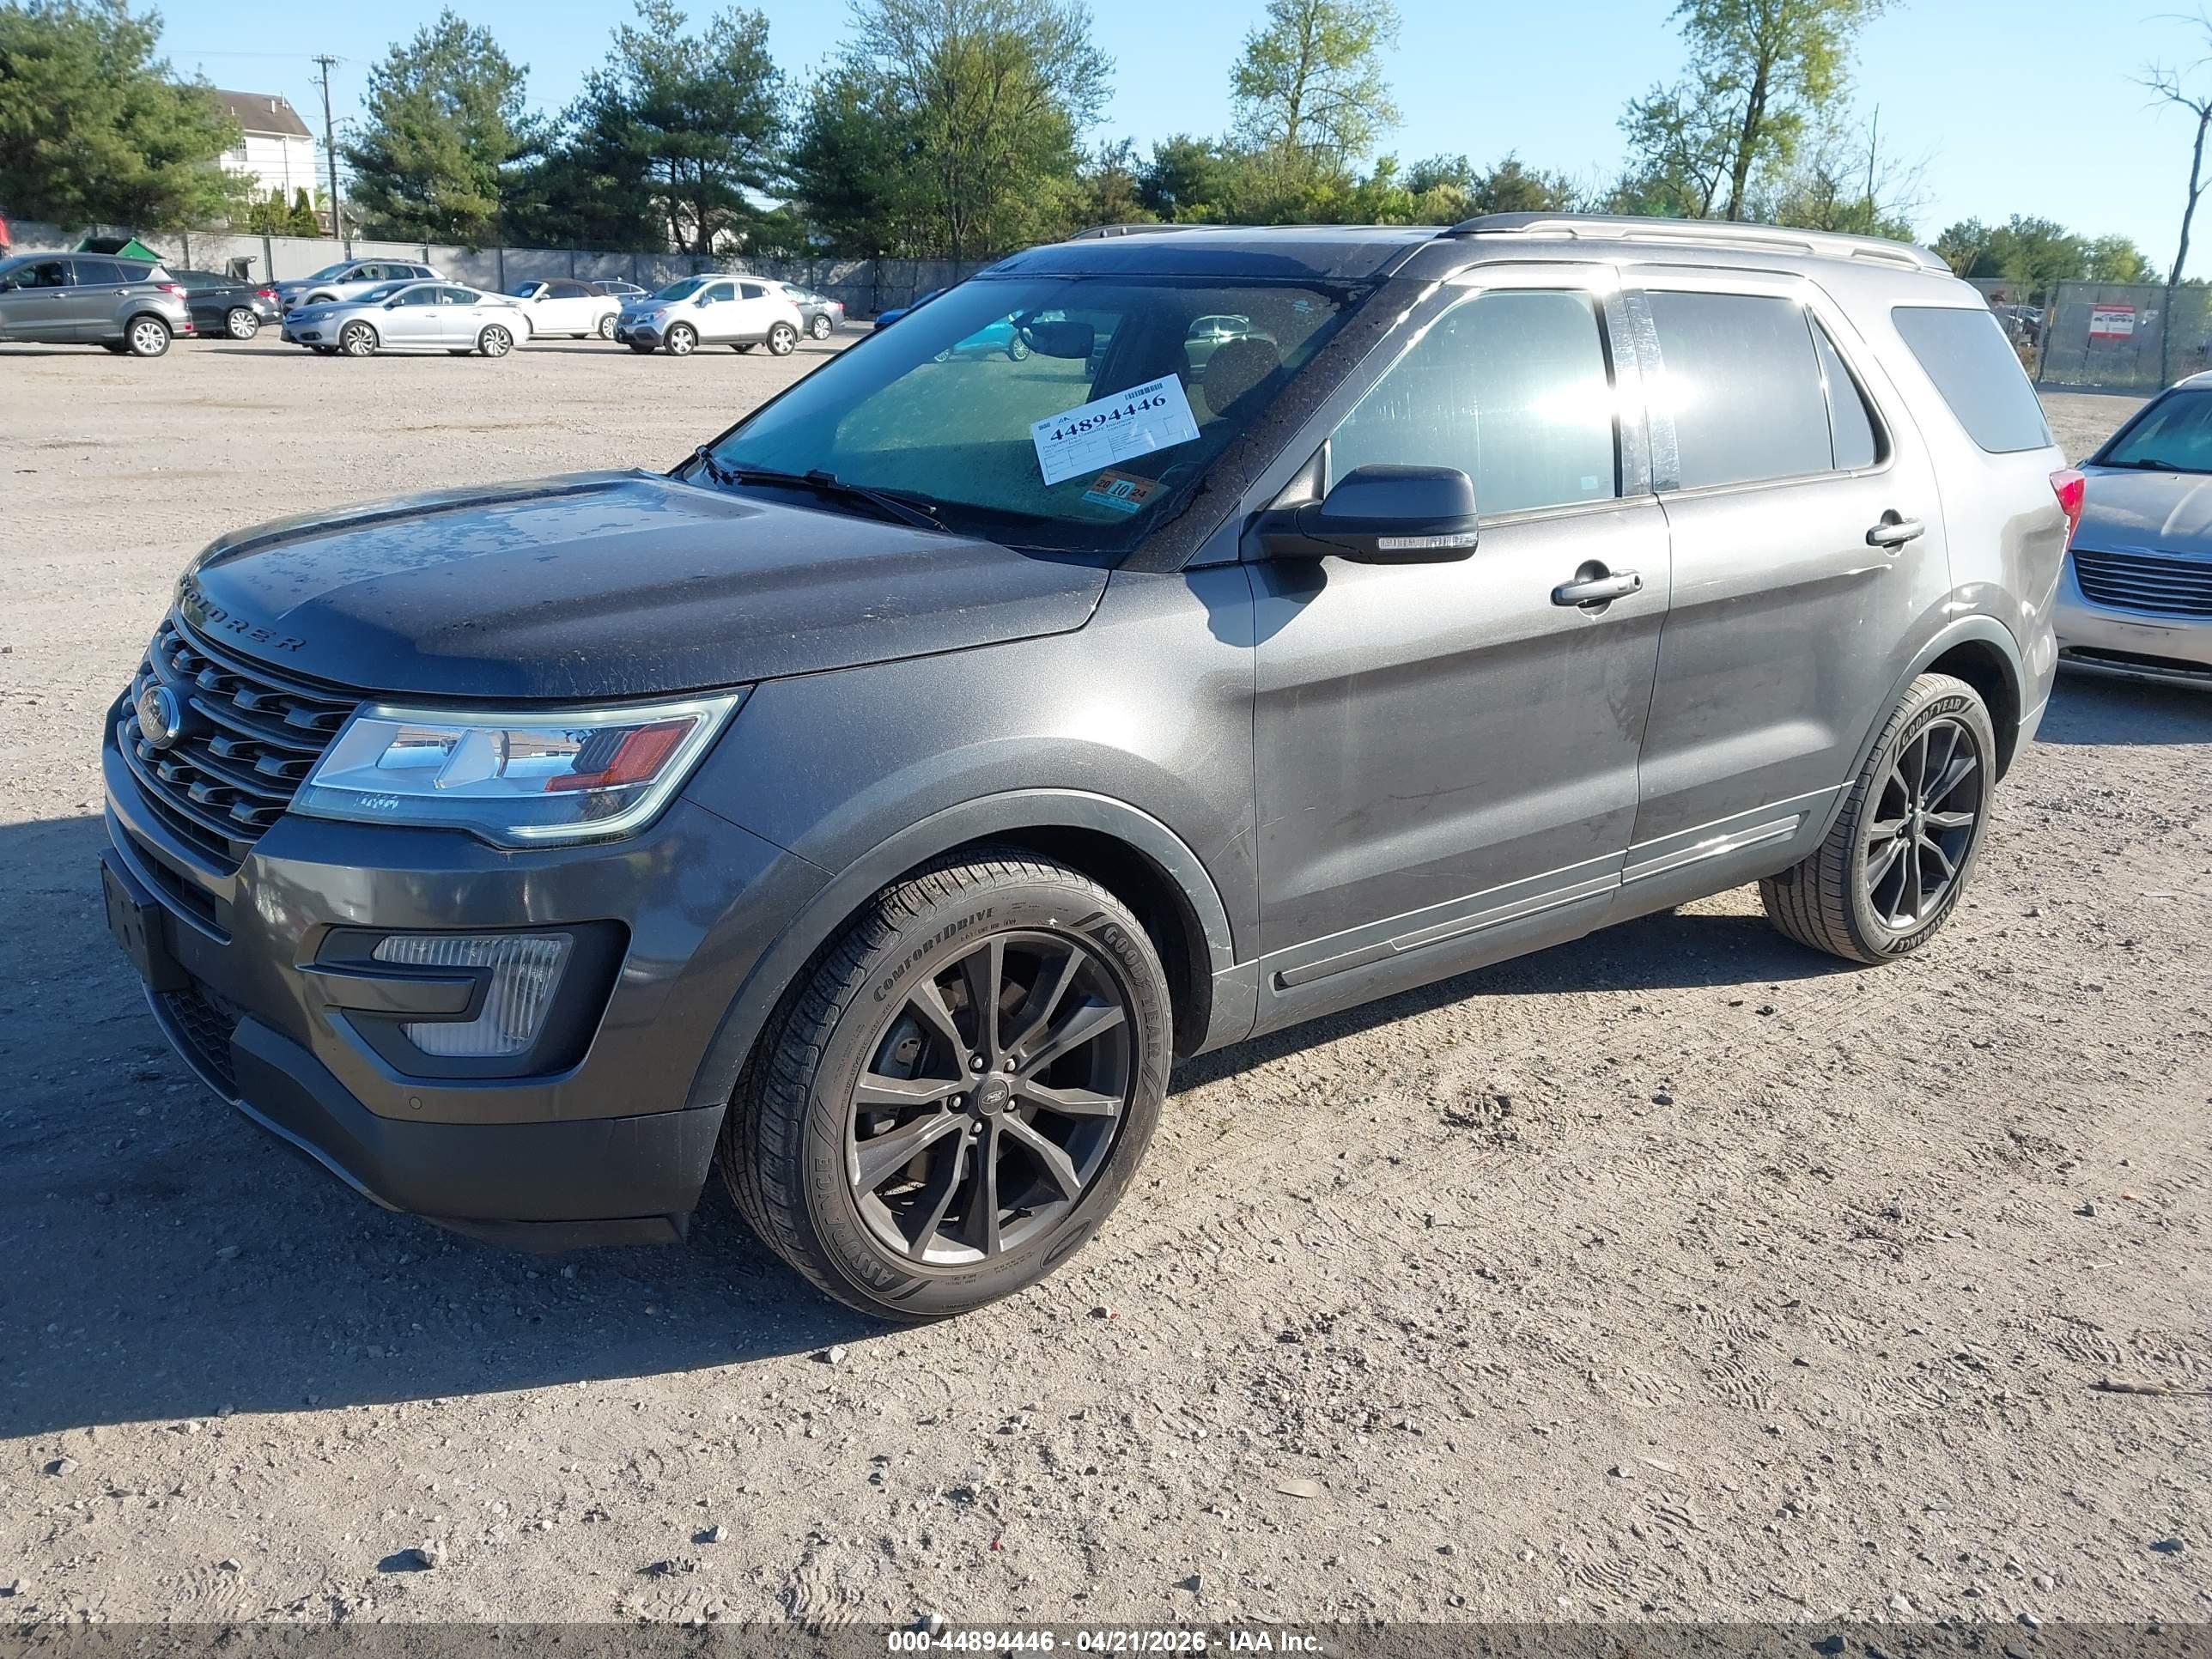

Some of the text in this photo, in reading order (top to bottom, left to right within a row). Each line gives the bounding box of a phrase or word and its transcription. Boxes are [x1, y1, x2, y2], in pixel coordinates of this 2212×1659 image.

[1050, 393, 1166, 441] 44894446
[1111, 483, 1130, 496] 10
[1902, 698, 1961, 746] GOODYEAR
[872, 907, 994, 1002] COMFORTDRIVE
[1103, 926, 1161, 1059] GOODYEAR
[815, 1157, 895, 1286] ASSURANCE
